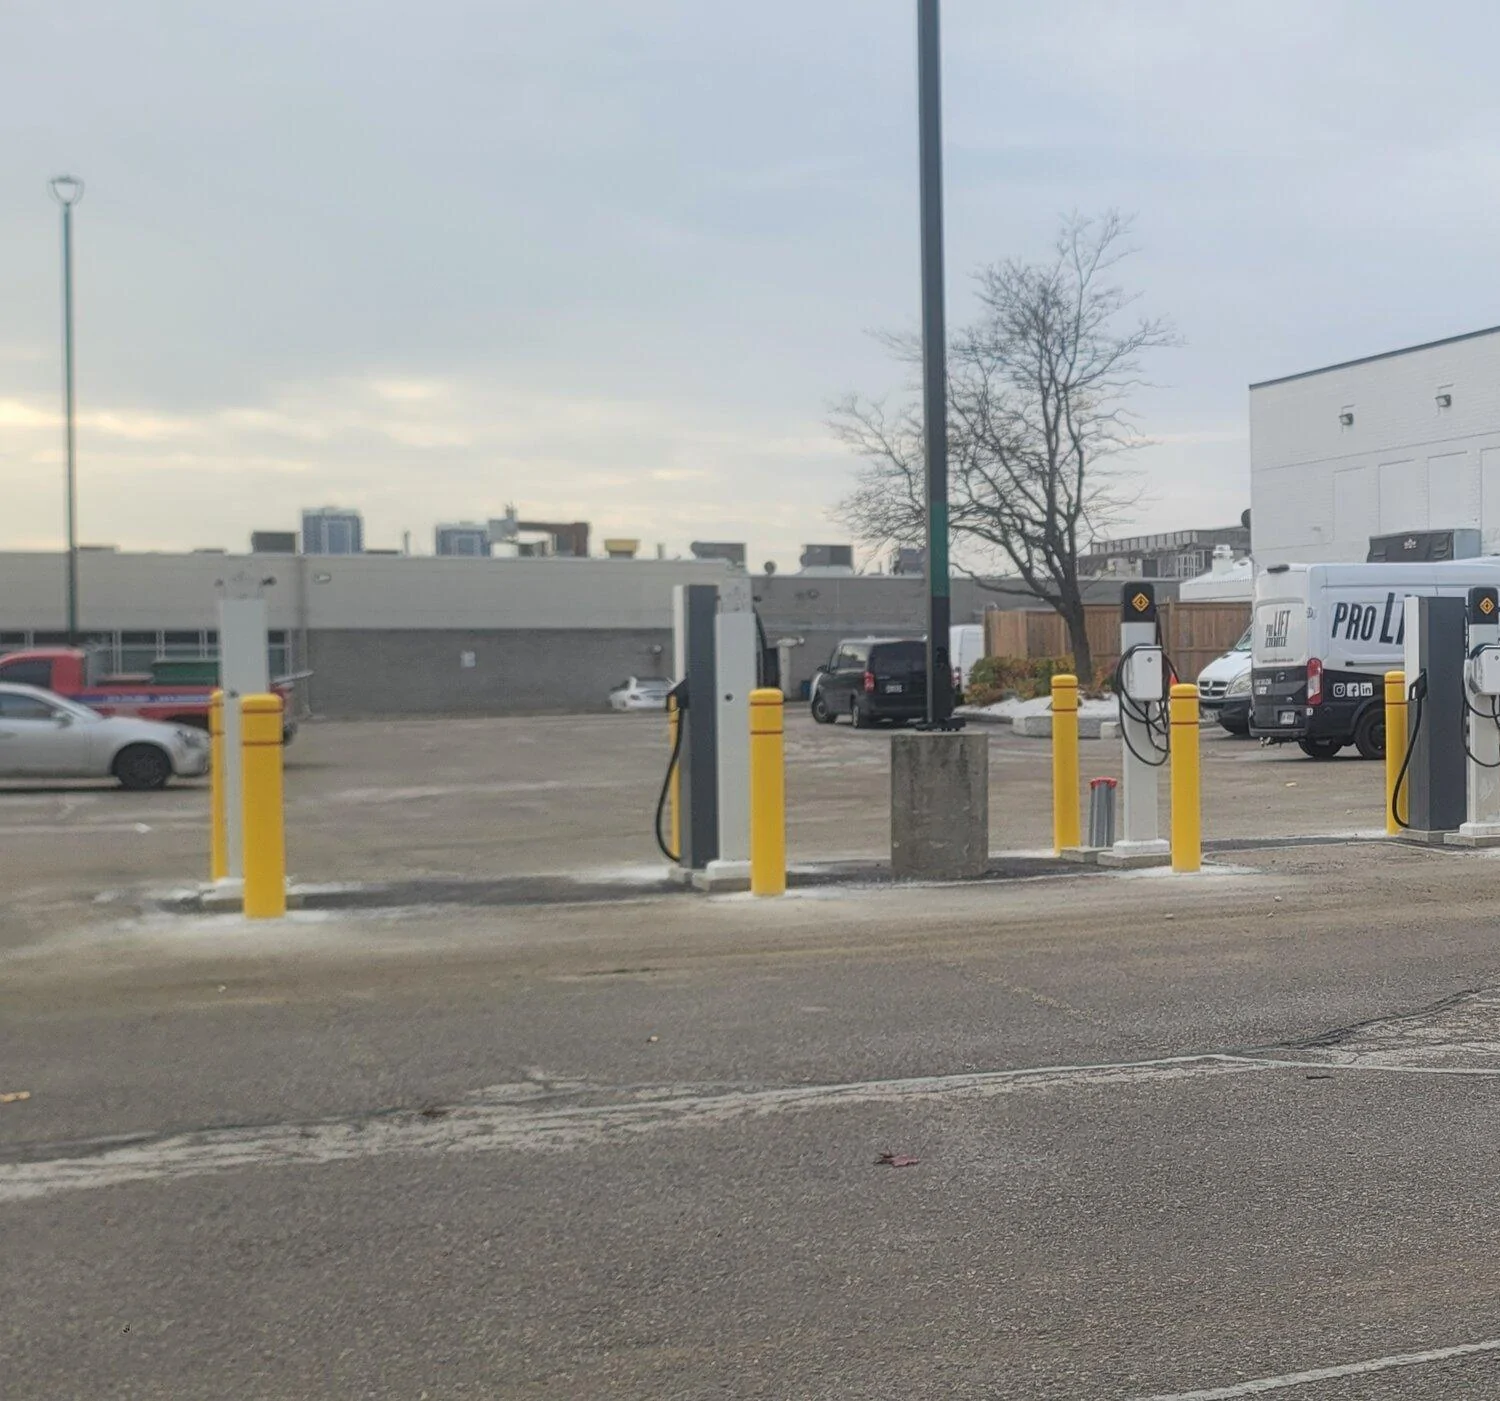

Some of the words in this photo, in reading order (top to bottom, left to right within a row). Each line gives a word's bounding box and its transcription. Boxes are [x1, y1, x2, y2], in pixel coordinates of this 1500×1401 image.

[1273, 610, 1291, 637] LIFT
[1331, 602, 1377, 641] PRO
[1379, 592, 1405, 645] LI
